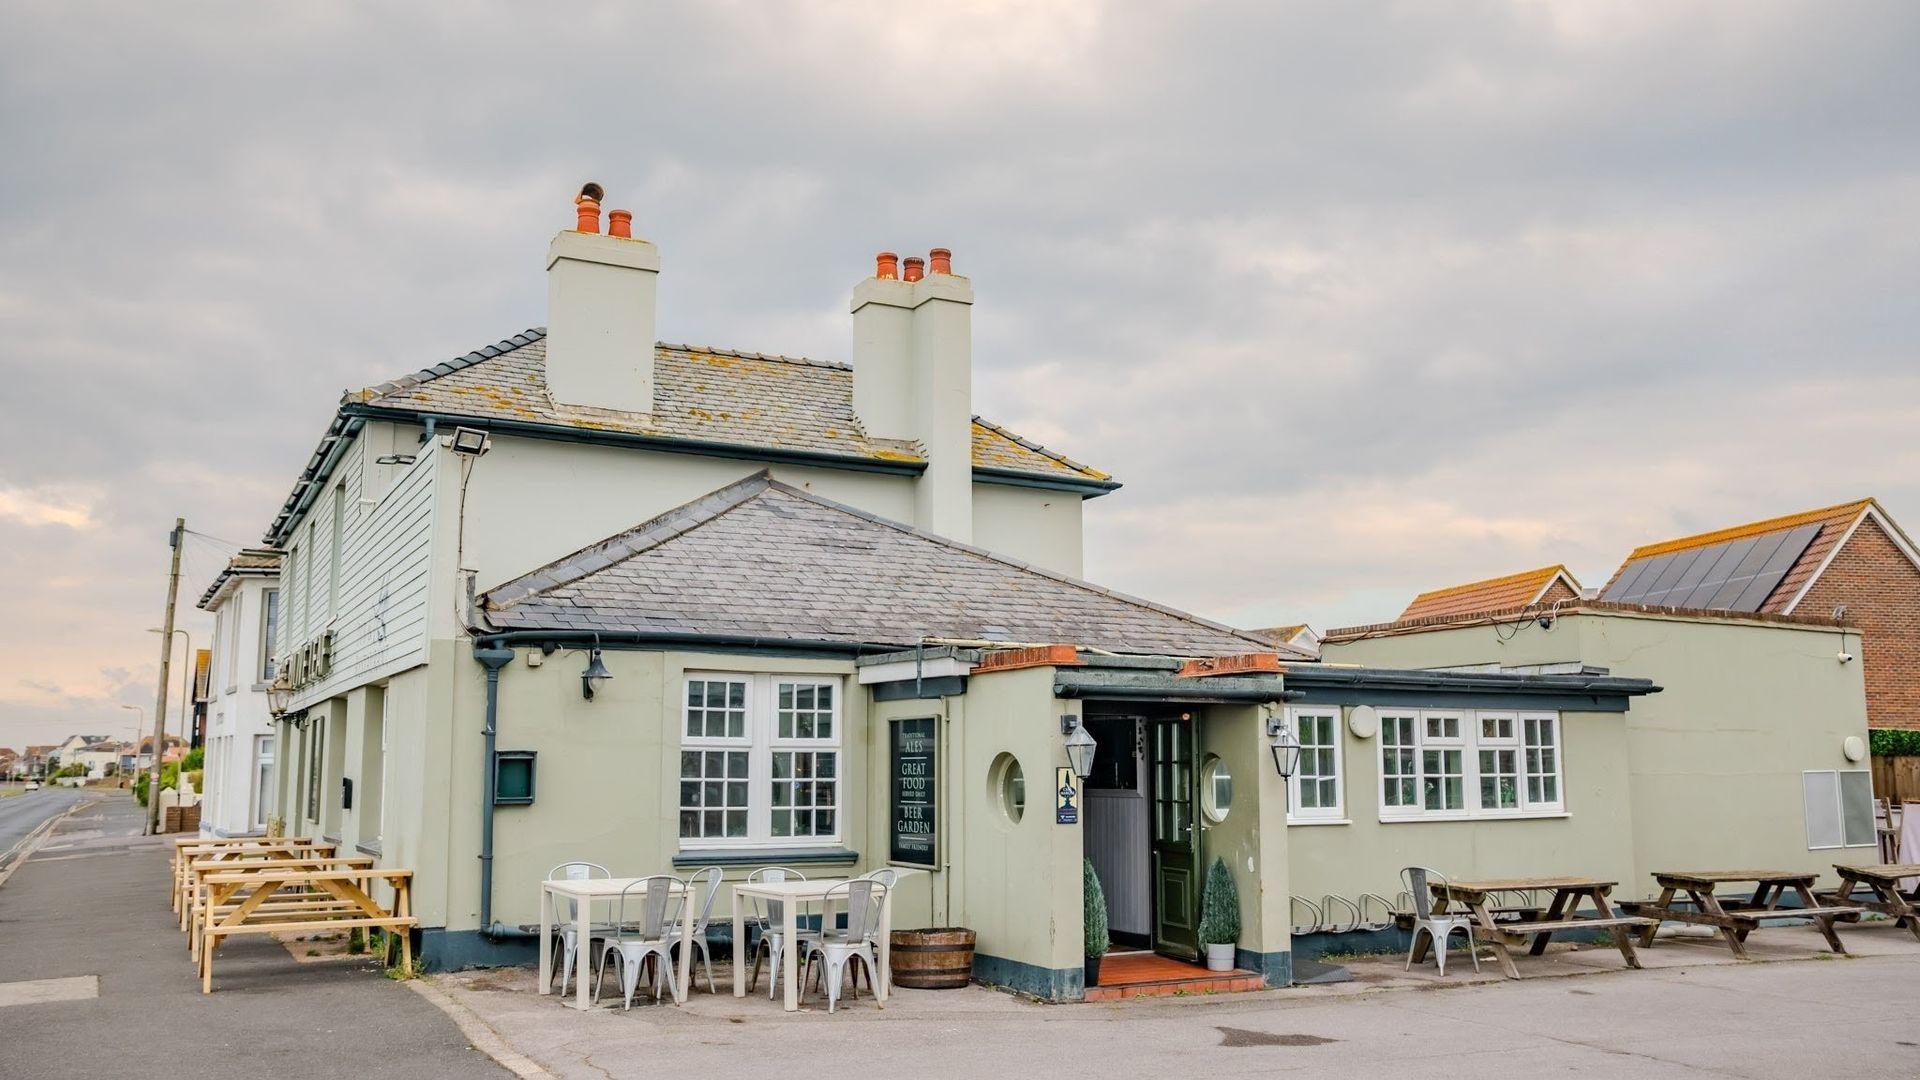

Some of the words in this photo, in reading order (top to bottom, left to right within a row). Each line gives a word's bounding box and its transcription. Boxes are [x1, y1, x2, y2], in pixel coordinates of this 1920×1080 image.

[905, 740, 923, 753] ALES
[901, 763, 926, 775] GREAT
[903, 777, 925, 789] FOOD
[904, 806, 923, 819] BEER
[897, 820, 930, 834] GARDEN
